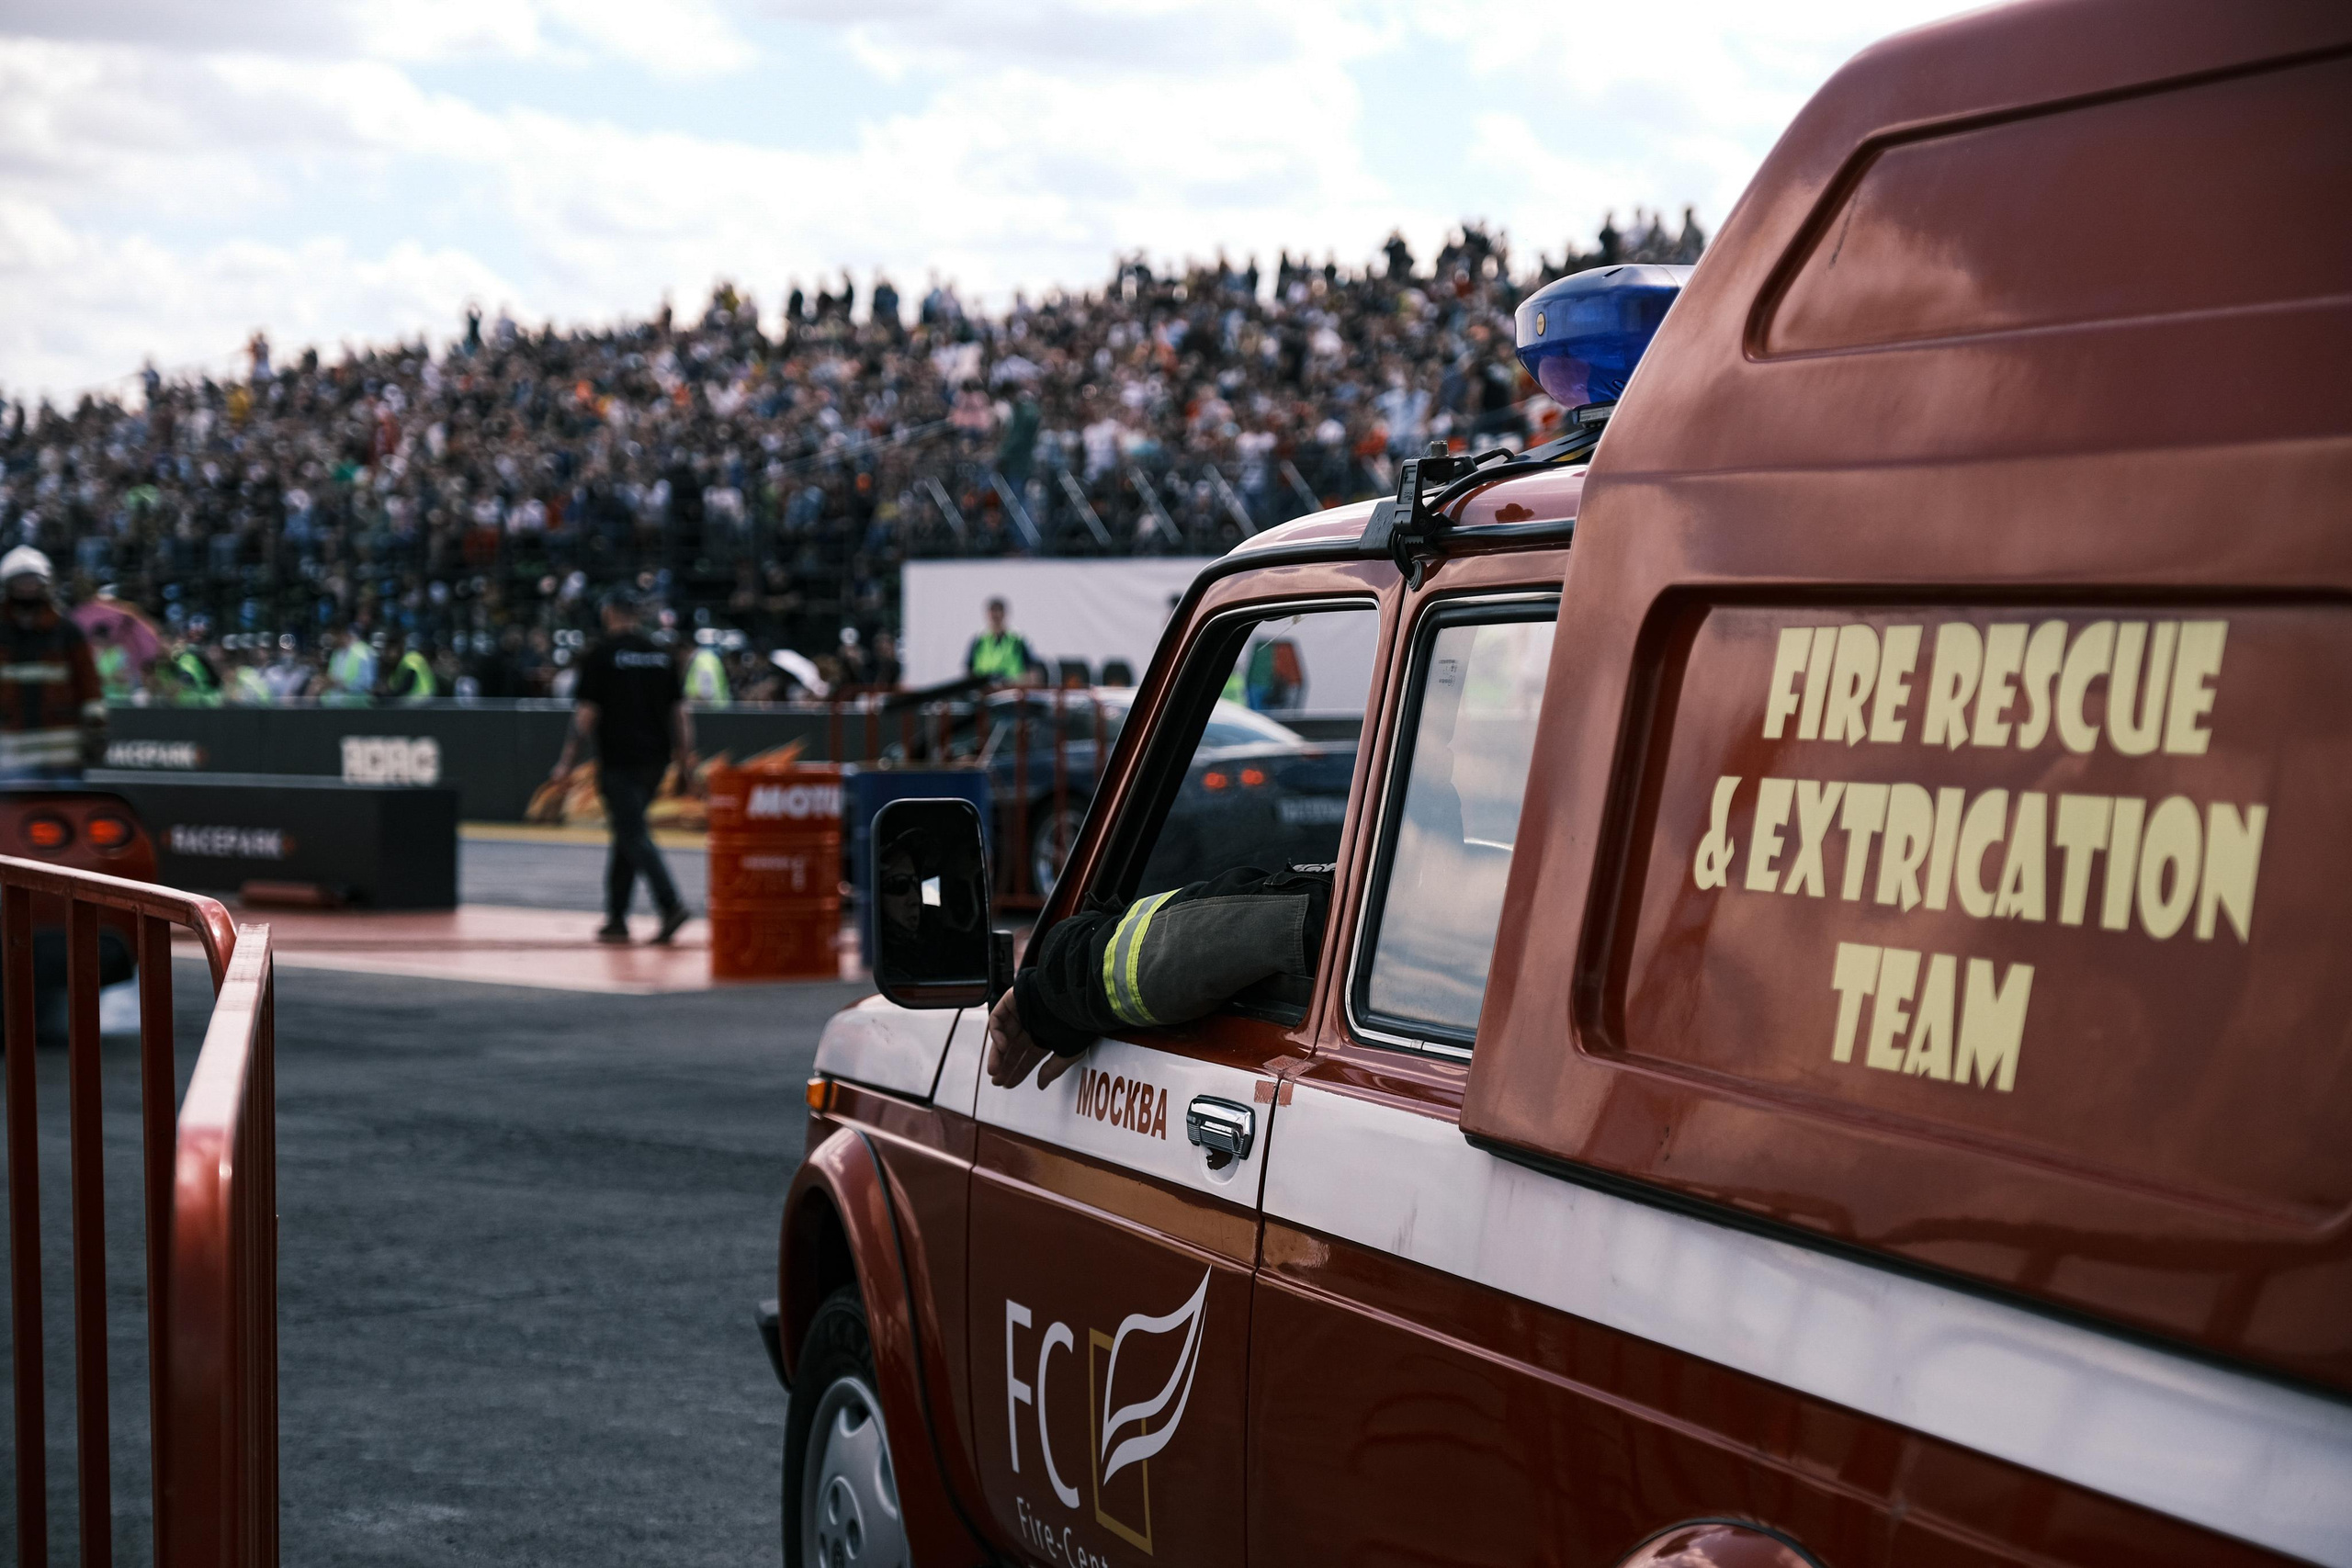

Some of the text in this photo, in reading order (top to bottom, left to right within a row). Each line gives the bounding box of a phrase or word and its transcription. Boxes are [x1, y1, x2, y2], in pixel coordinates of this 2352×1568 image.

[1762, 620, 2230, 756] FIRE RESCUE
[1693, 776, 2269, 944] & EXTRICATION
[1831, 942, 2036, 1094] TEAM
[1076, 1066, 1169, 1141] МОСКВА
[1006, 1299, 1080, 1509] FC
